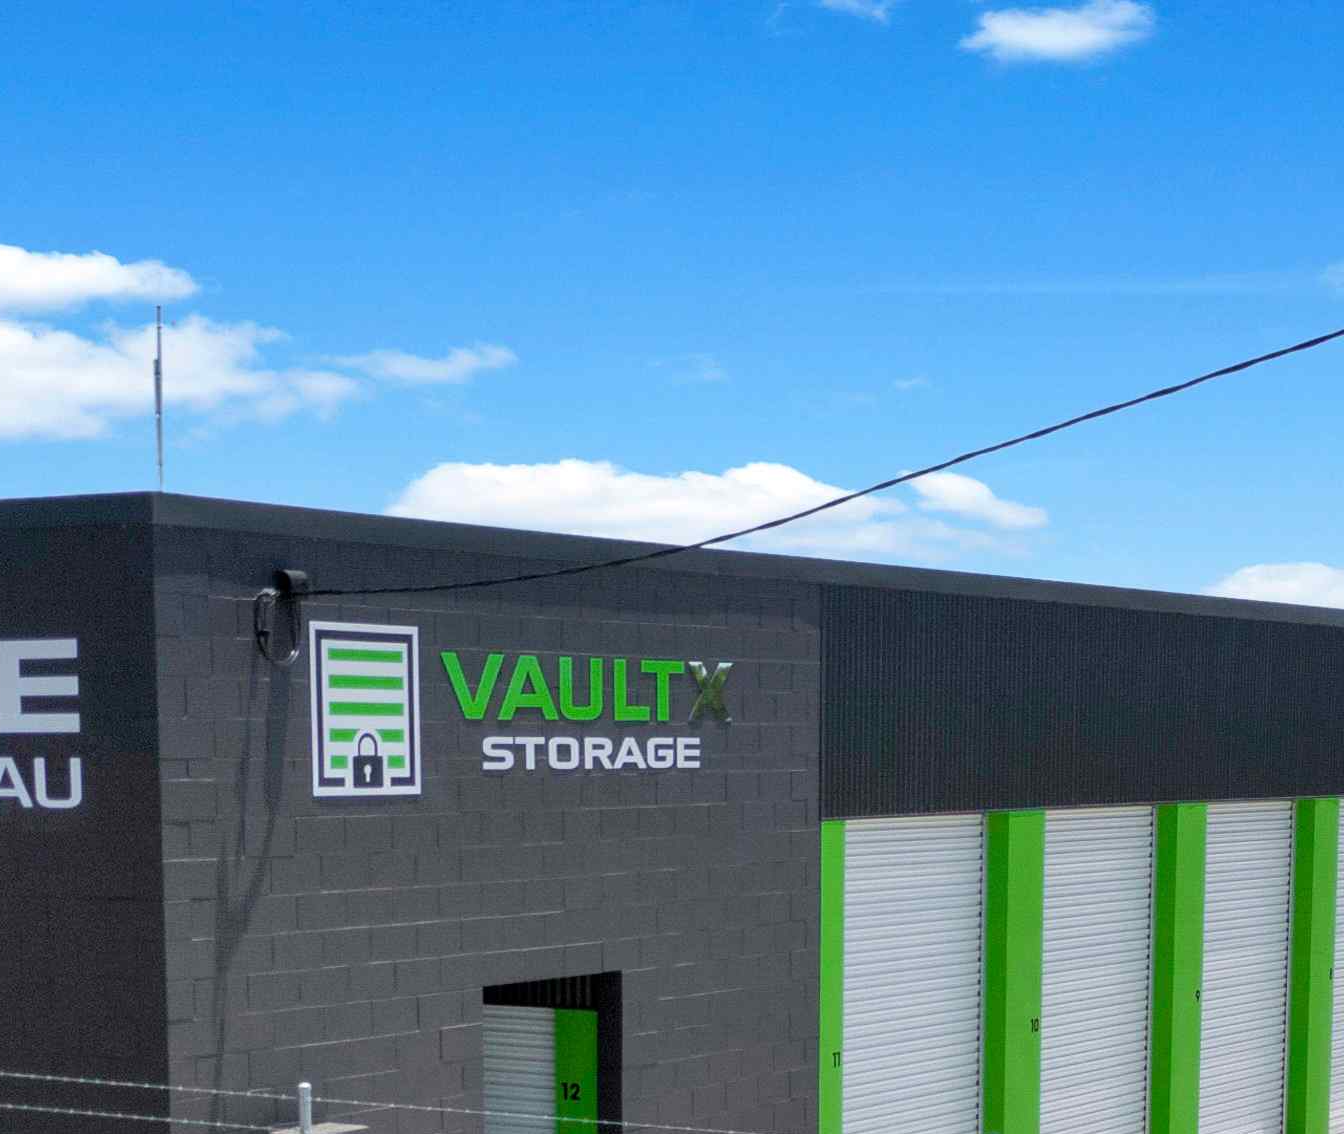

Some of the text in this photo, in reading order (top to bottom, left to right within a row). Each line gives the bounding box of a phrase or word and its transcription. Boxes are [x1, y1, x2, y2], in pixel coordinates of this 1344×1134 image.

[440, 650, 734, 724] VAULTX
[482, 735, 701, 771] STORAGE
[1029, 1018, 1040, 1033] 10
[831, 1051, 841, 1068] 11
[560, 1081, 582, 1101] 12
